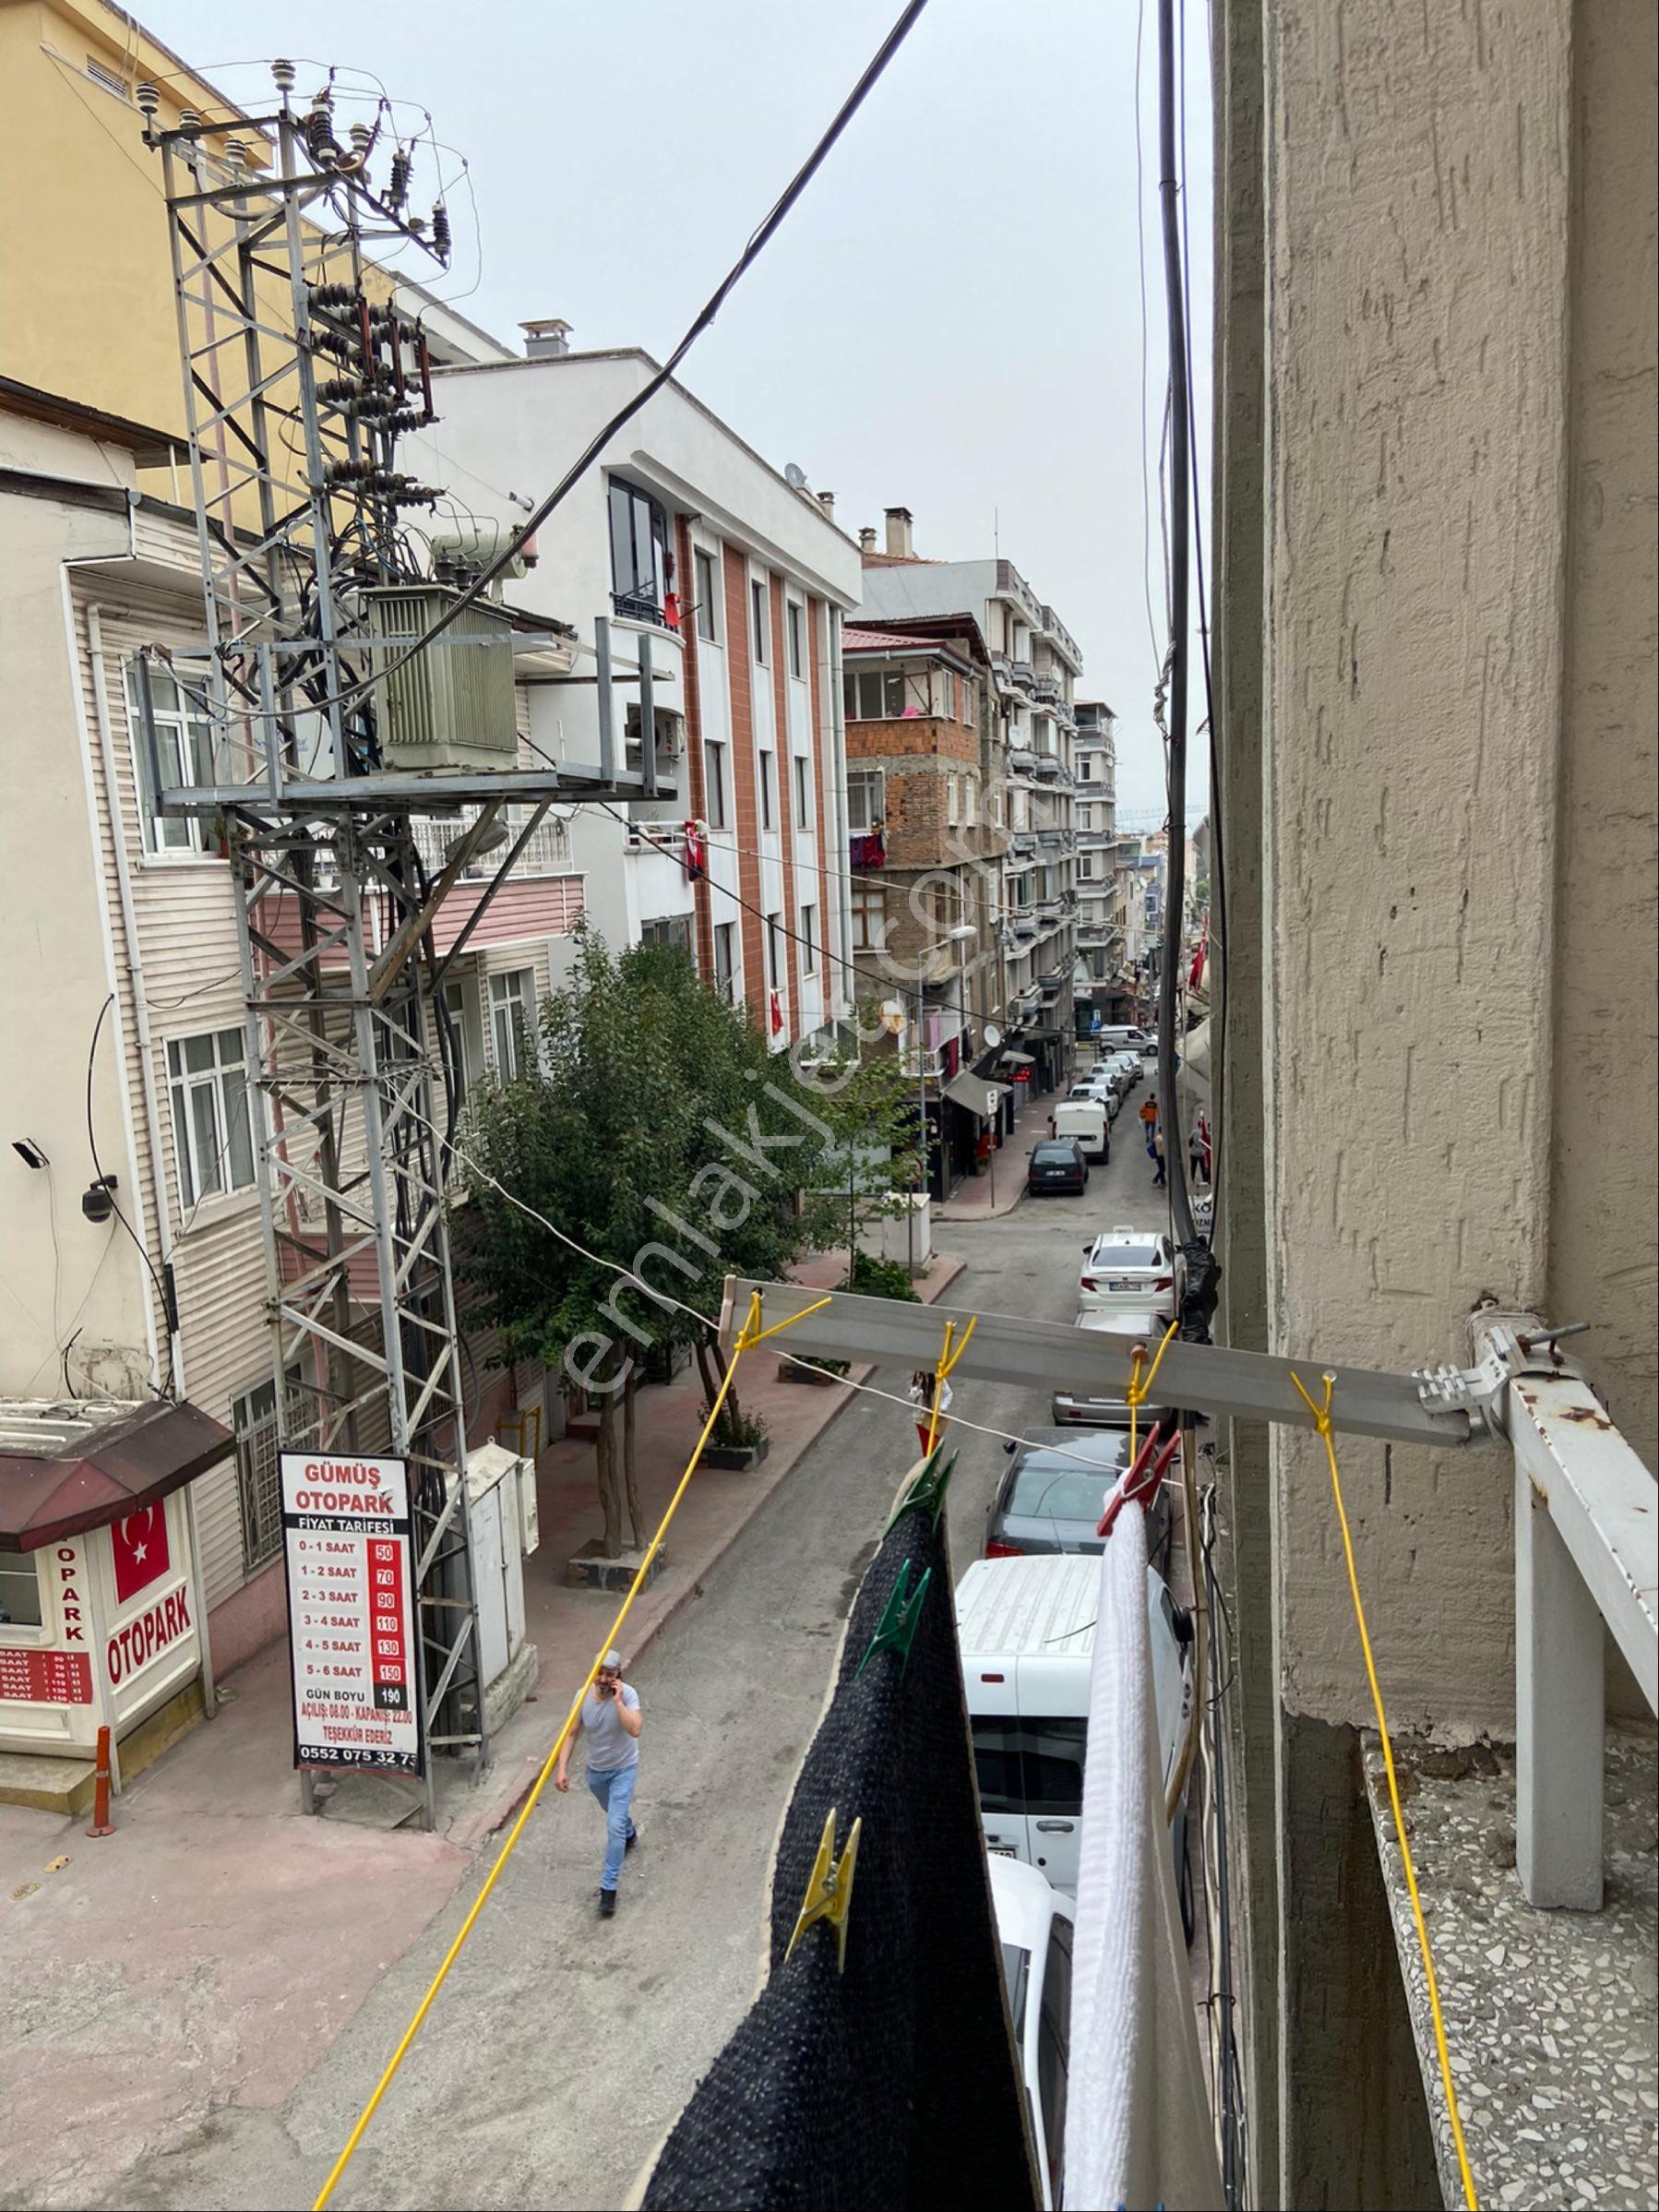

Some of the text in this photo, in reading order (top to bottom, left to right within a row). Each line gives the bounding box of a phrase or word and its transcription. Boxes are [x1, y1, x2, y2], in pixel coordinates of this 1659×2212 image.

[304, 1460, 381, 1489] GÜMÜŞ
[295, 1489, 394, 1514] OTOPARK
[298, 1514, 395, 1535] FİYAT TARİFESİ
[299, 1540, 306, 1550] 0
[316, 1541, 322, 1551] 1
[326, 1542, 355, 1553] SAAT
[377, 1546, 392, 1560] 50
[301, 1565, 307, 1575] 1
[317, 1566, 325, 1576] 2
[328, 1566, 357, 1578] SAAT
[378, 1571, 393, 1584] 70
[57, 1538, 84, 1641] OPARK
[302, 1590, 309, 1600] 2
[318, 1590, 326, 1601] 3
[328, 1591, 358, 1603] SAAT
[379, 1594, 394, 1607] 90
[304, 1614, 311, 1625] 3
[320, 1615, 328, 1626] 4
[330, 1616, 360, 1628] SAAT
[378, 1618, 396, 1631] 110
[107, 1585, 192, 1685] OTOPARK
[305, 1639, 313, 1650] 4
[322, 1640, 329, 1651] 5
[332, 1640, 361, 1652] SAAT
[379, 1641, 398, 1654] 130
[306, 1664, 314, 1675] 5
[323, 1665, 330, 1676] 6
[332, 1666, 363, 1678] SAAT
[381, 1667, 400, 1680] 150
[306, 1688, 400, 1704] GÜN BOYU 190
[323, 1725, 393, 1745] TEŞEKKÜR EDERİZ
[301, 1747, 340, 1760] 0552
[342, 1750, 372, 1762] 075
[376, 1751, 396, 1764] 32
